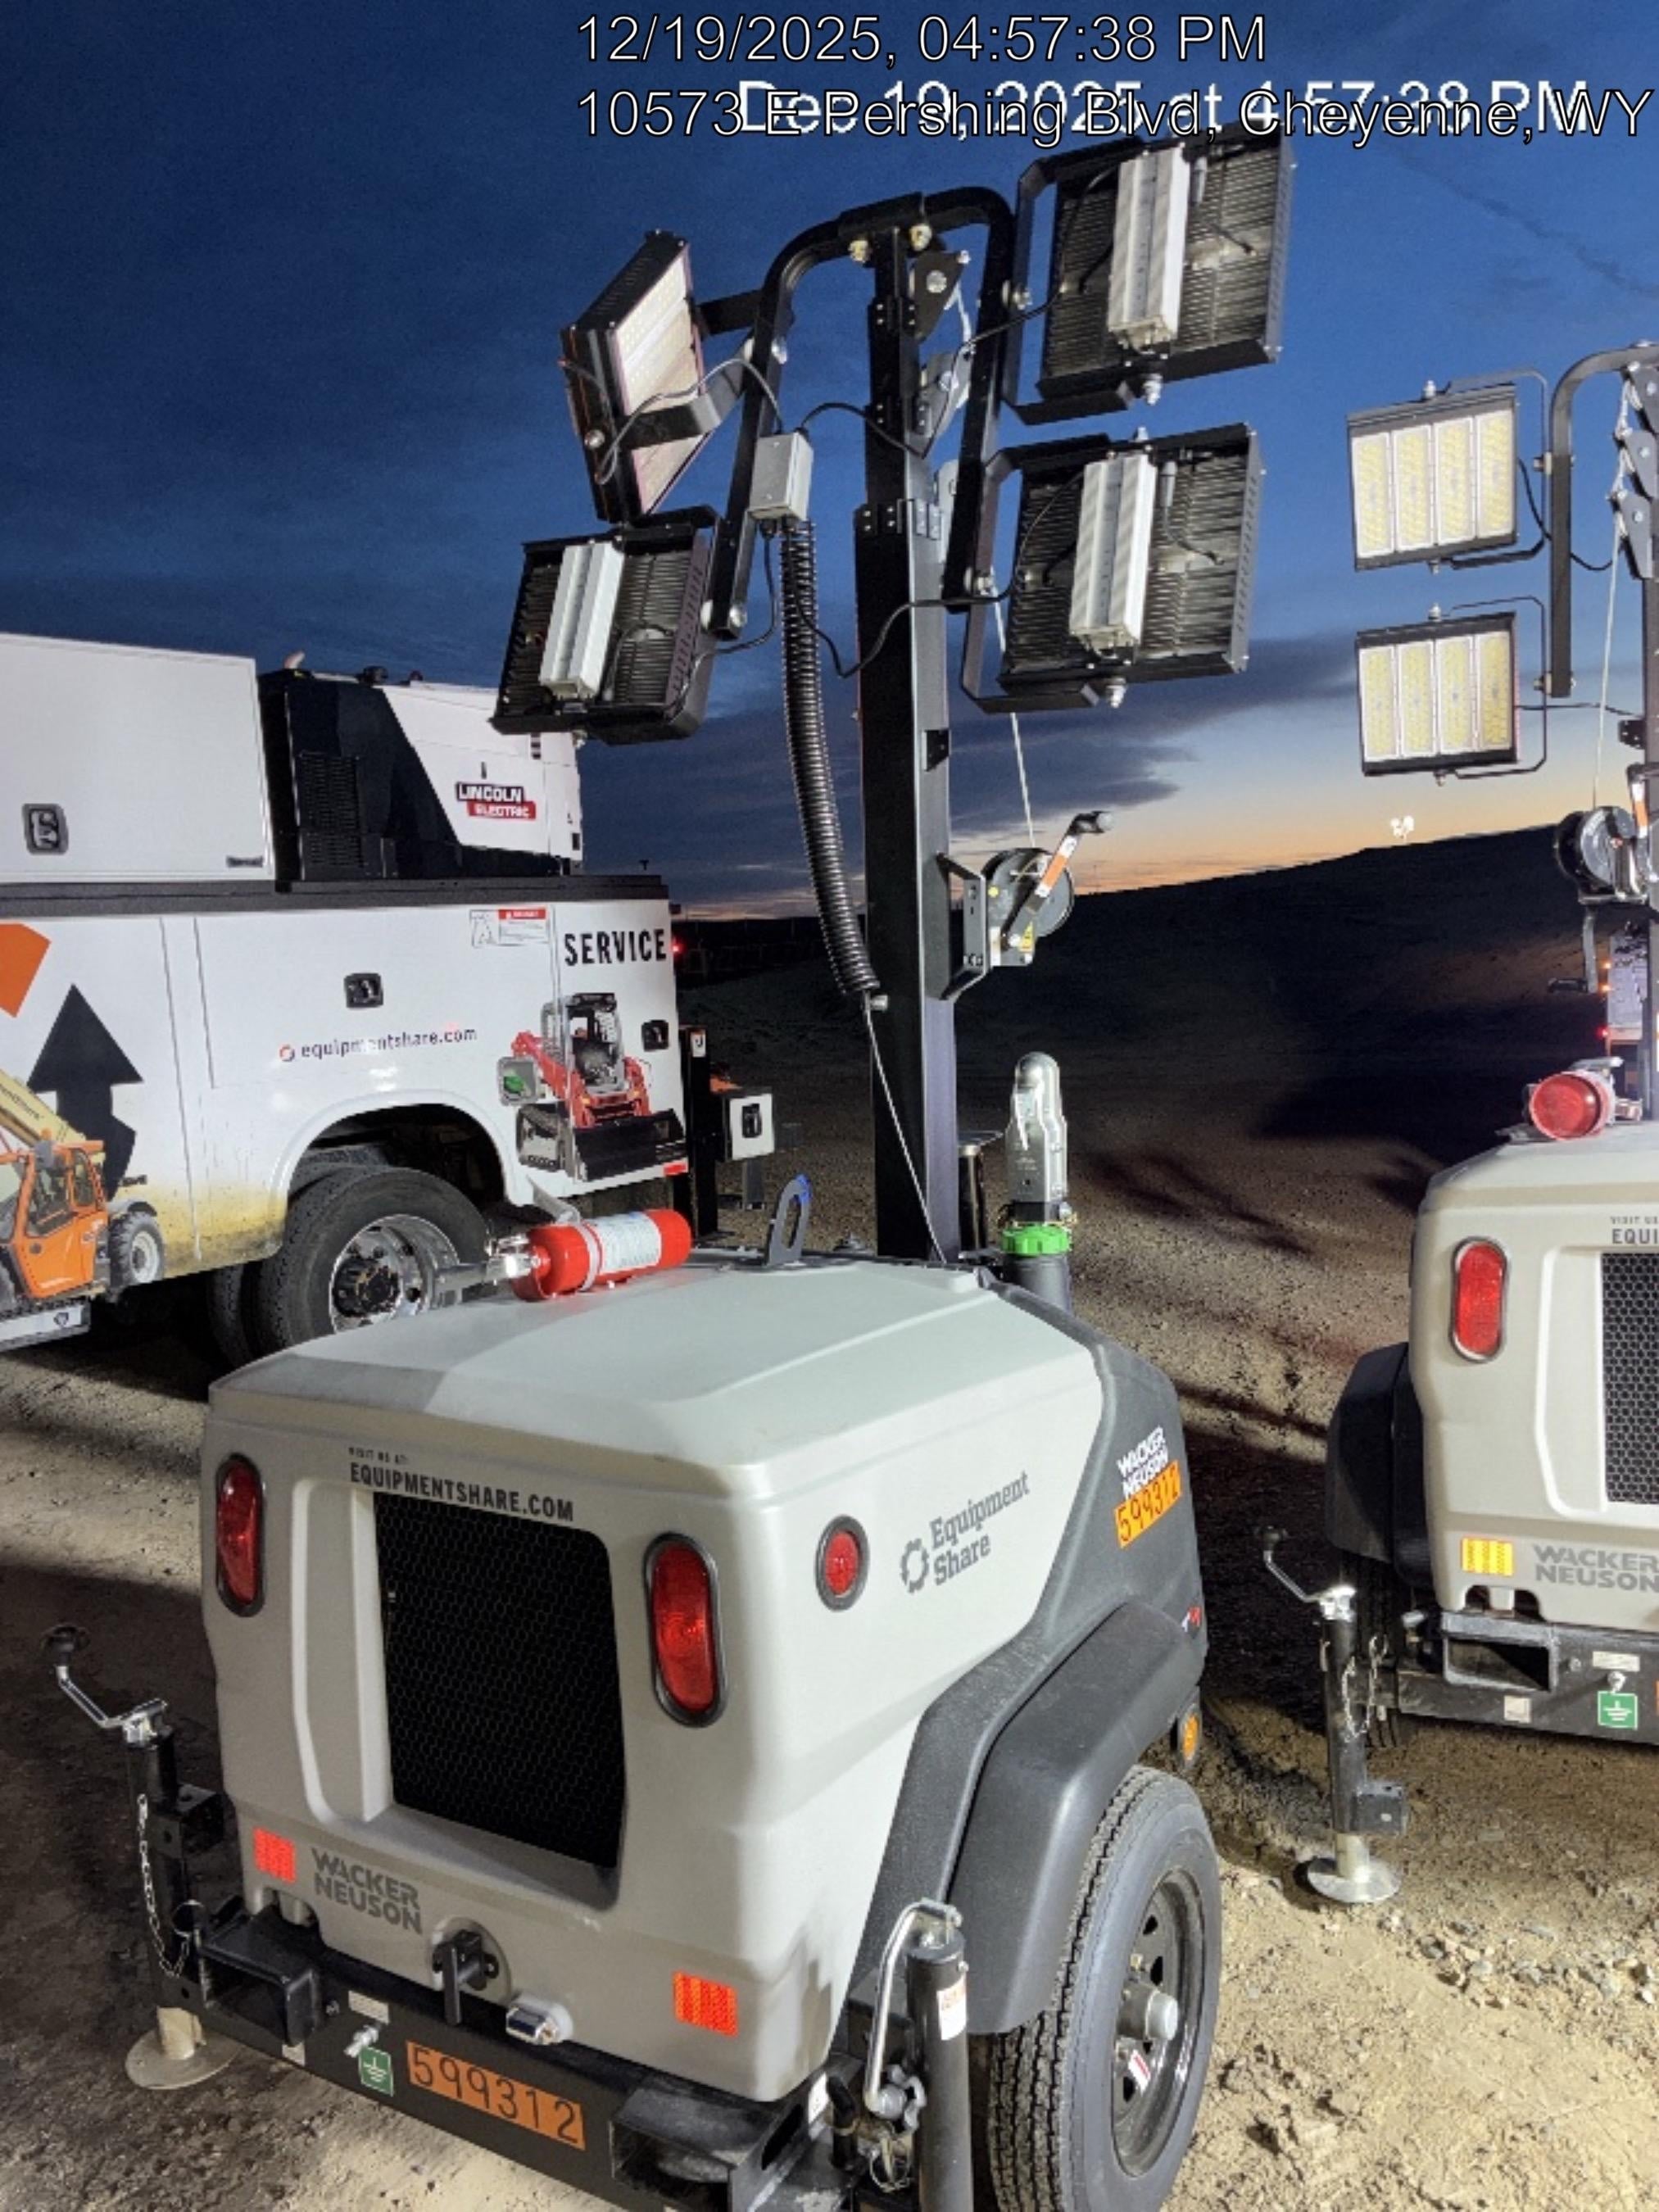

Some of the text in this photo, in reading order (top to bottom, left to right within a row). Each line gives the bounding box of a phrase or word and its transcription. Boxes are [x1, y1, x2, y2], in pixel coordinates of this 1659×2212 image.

[457, 782, 523, 803] LINCOLN
[474, 803, 531, 818] ELECTRIC
[564, 928, 667, 967] SERVICE
[350, 1462, 573, 1522] EQUIPMENTSHARE.COM
[929, 1470, 1030, 1550] Equipment
[1117, 1463, 1180, 1542] 599312
[933, 1534, 991, 1586] Share
[1534, 1544, 1659, 1574] WACKER
[1535, 1566, 1659, 1593] NEUSON
[311, 1847, 420, 1911] WACKER
[315, 1873, 423, 1935] NEUSON
[413, 2049, 578, 2144] 599312
